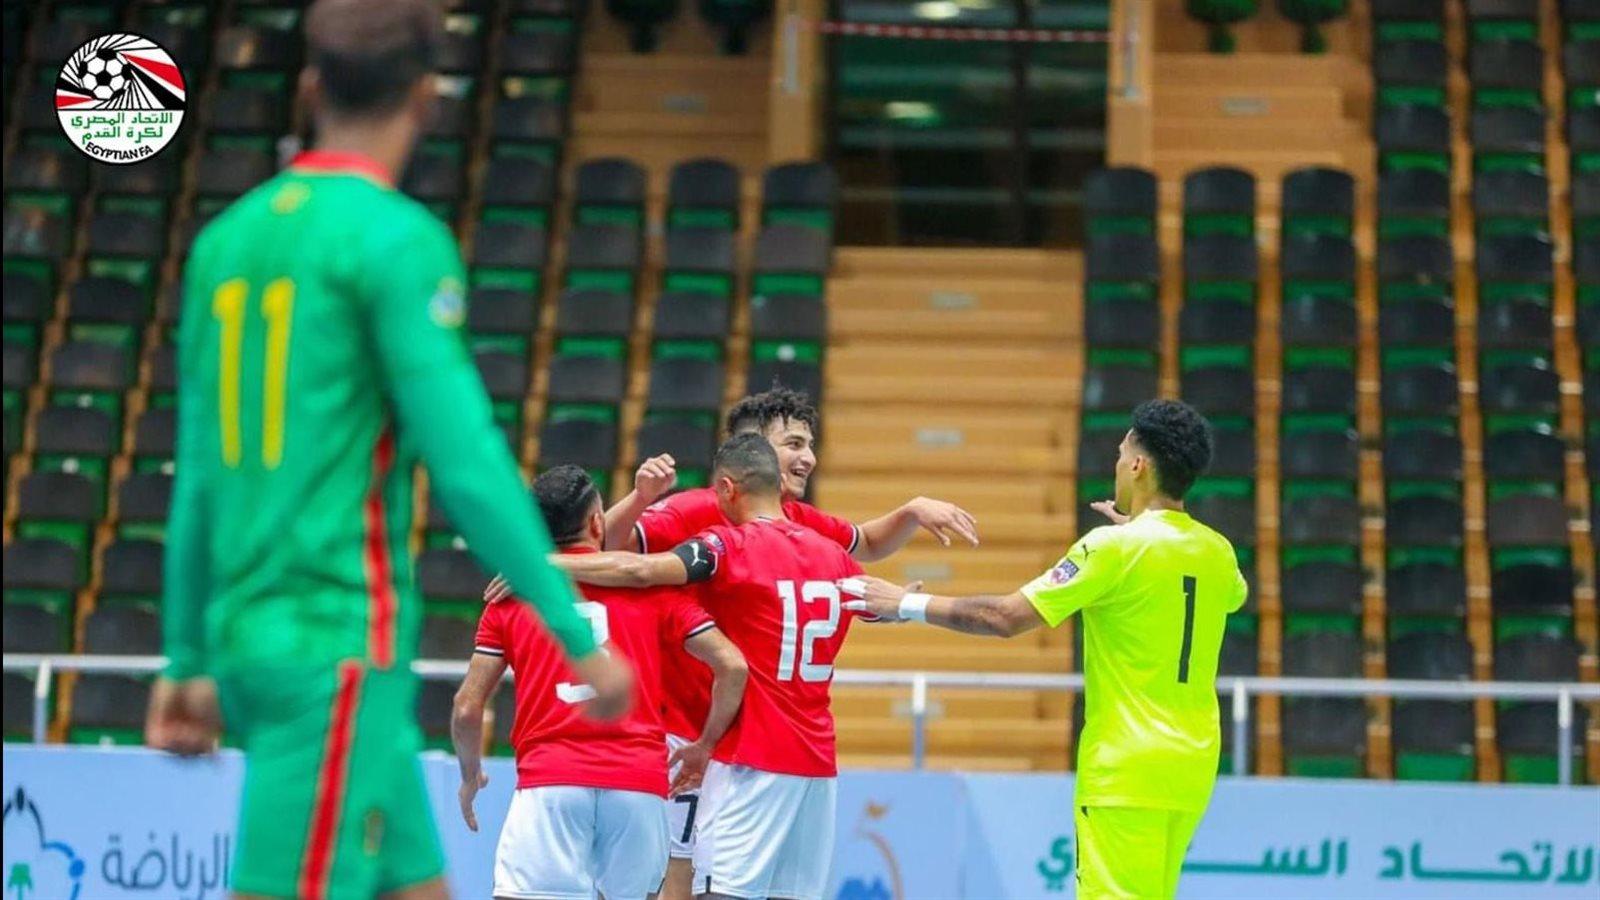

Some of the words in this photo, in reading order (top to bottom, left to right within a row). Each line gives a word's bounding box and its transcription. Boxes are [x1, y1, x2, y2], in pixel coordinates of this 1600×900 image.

[211, 276, 296, 472] 11
[776, 580, 840, 682] 12
[1177, 574, 1197, 684] 1
[675, 794, 699, 844] 7
[1377, 838, 1600, 885] لاتحاد
